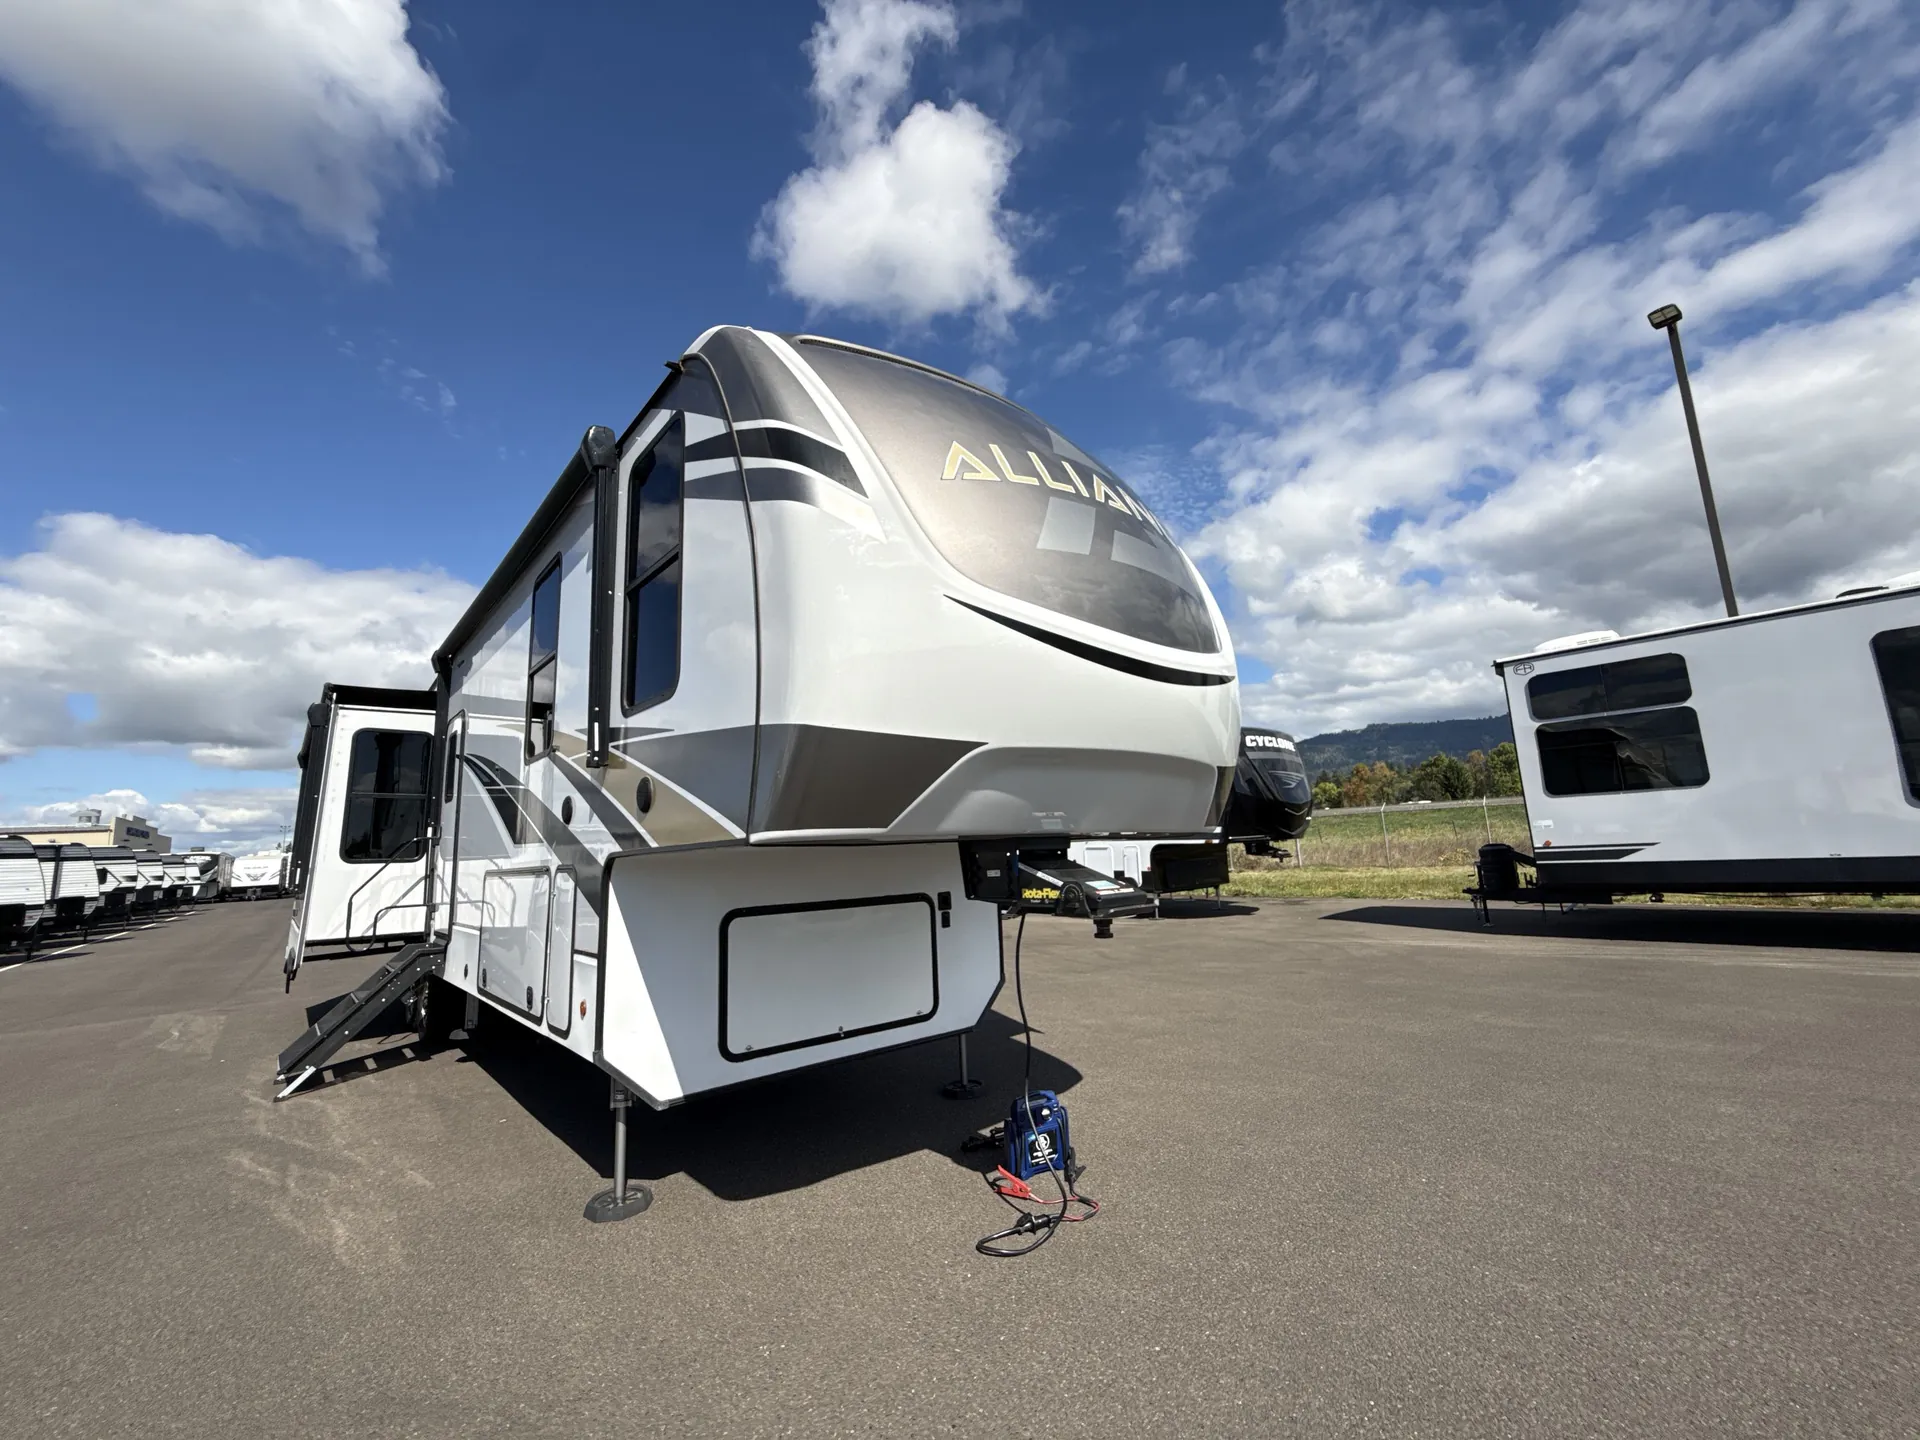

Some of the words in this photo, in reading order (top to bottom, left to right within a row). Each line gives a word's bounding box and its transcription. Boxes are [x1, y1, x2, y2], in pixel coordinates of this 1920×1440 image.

[941, 440, 1163, 536] ALLIAN
[1245, 735, 1296, 752] CYCLONE
[1021, 887, 1061, 899] Rota-Flex
